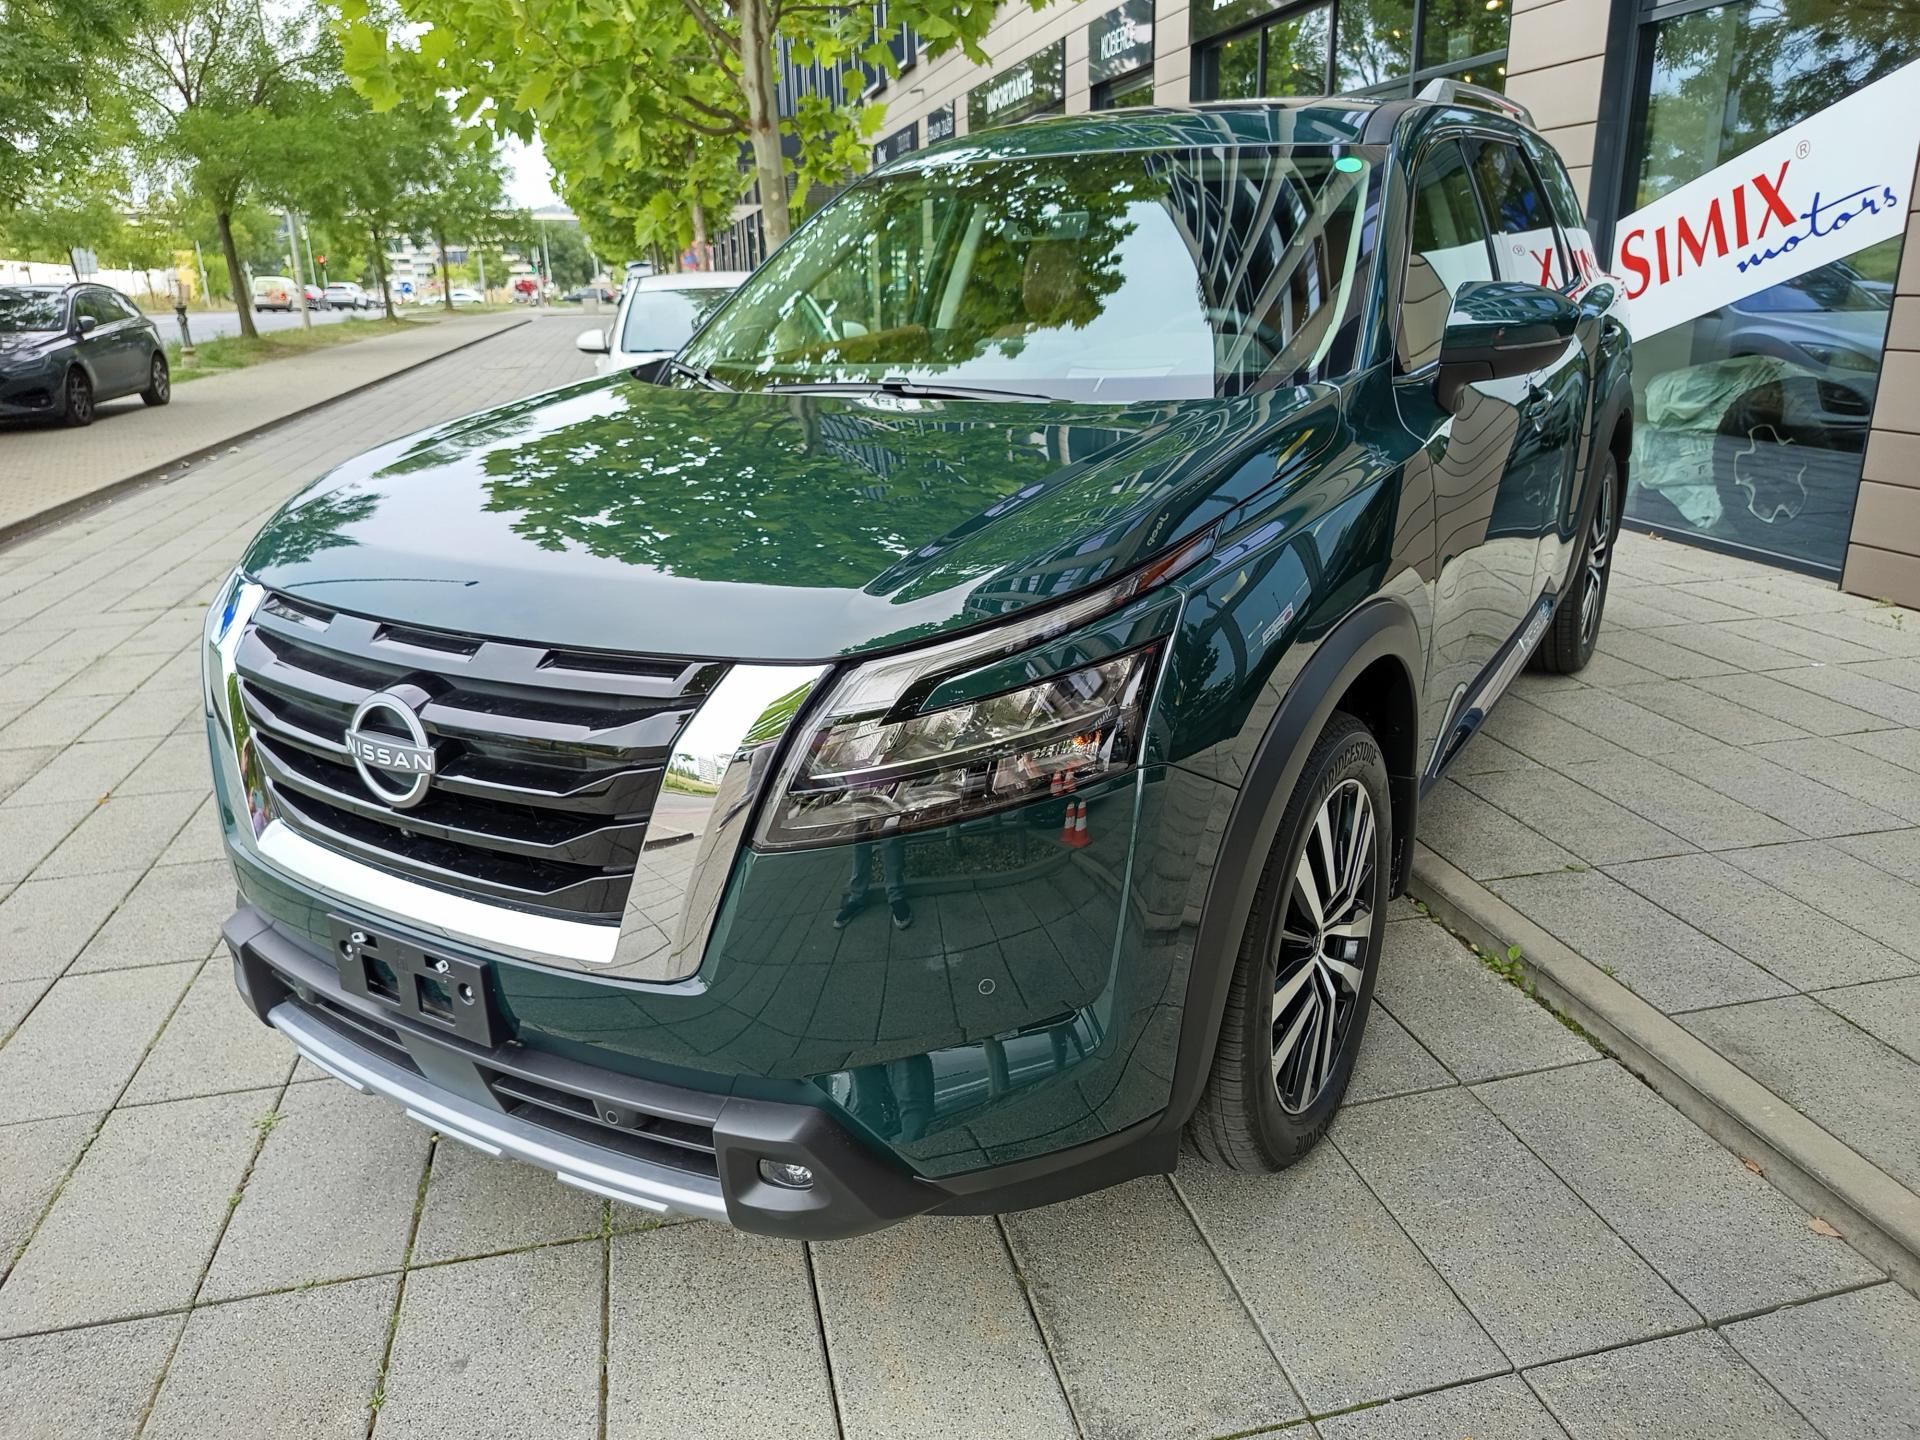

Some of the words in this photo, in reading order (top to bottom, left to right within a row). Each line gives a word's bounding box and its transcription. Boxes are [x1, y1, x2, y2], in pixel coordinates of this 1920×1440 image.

[987, 70, 1033, 115] IMPORTANTE
[1621, 160, 1796, 300] SIMIX
[1737, 184, 1898, 273] motors
[346, 735, 432, 770] NISSAN
